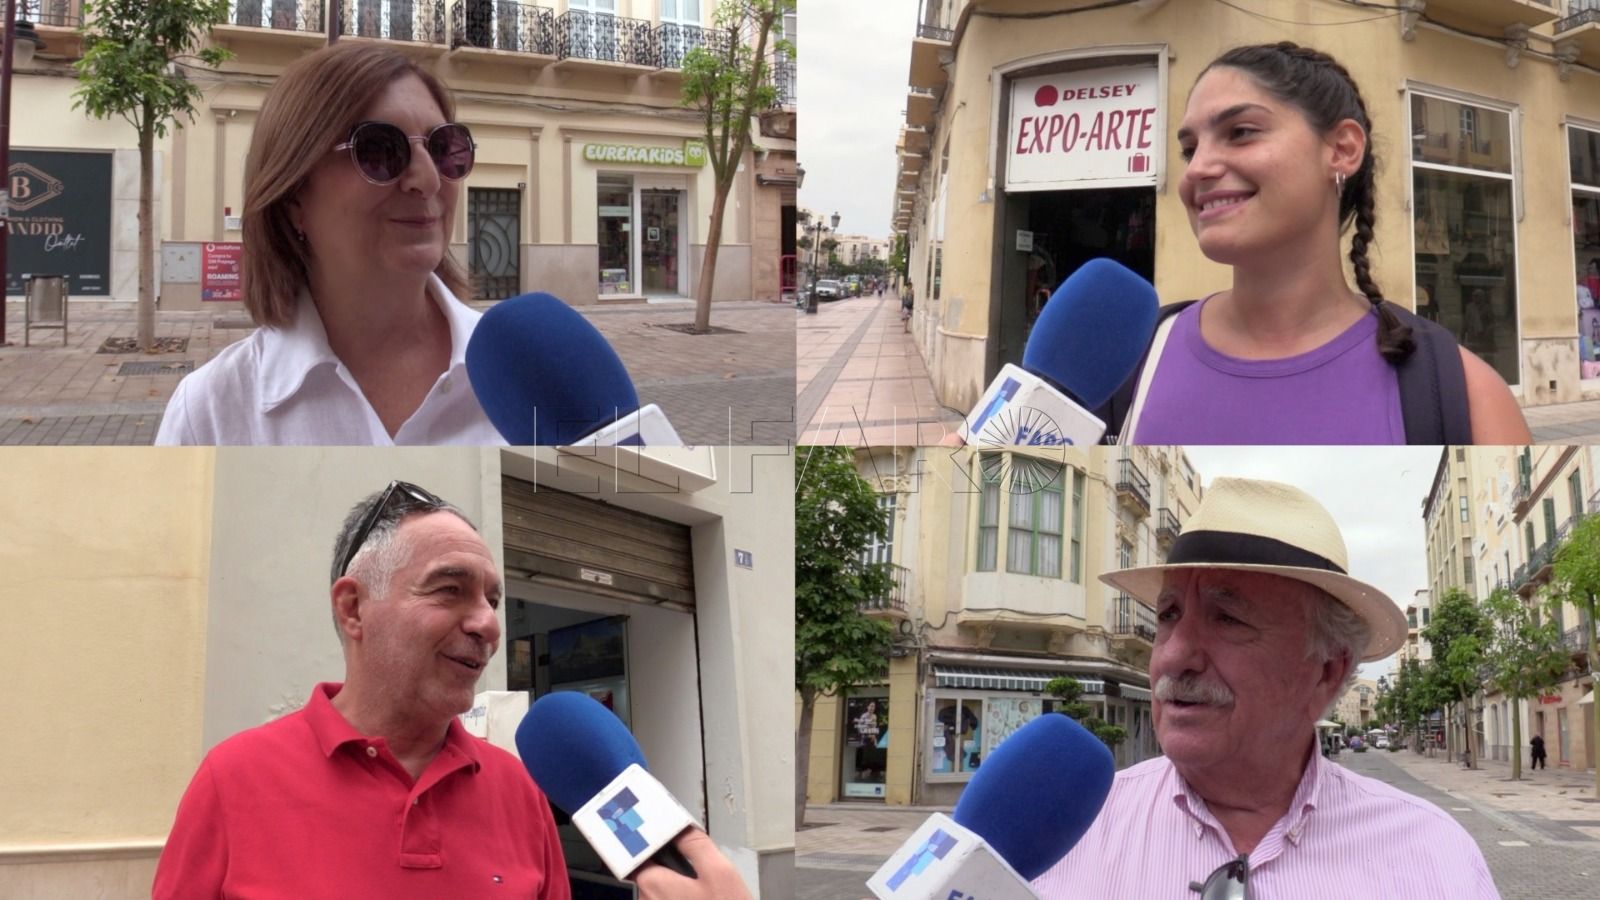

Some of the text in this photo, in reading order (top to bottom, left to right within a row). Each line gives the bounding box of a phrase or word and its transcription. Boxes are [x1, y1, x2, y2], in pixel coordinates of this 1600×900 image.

[1062, 84, 1137, 102] DELSEY
[1015, 107, 1157, 155] EXPO-ARTE
[11, 176, 32, 199] B
